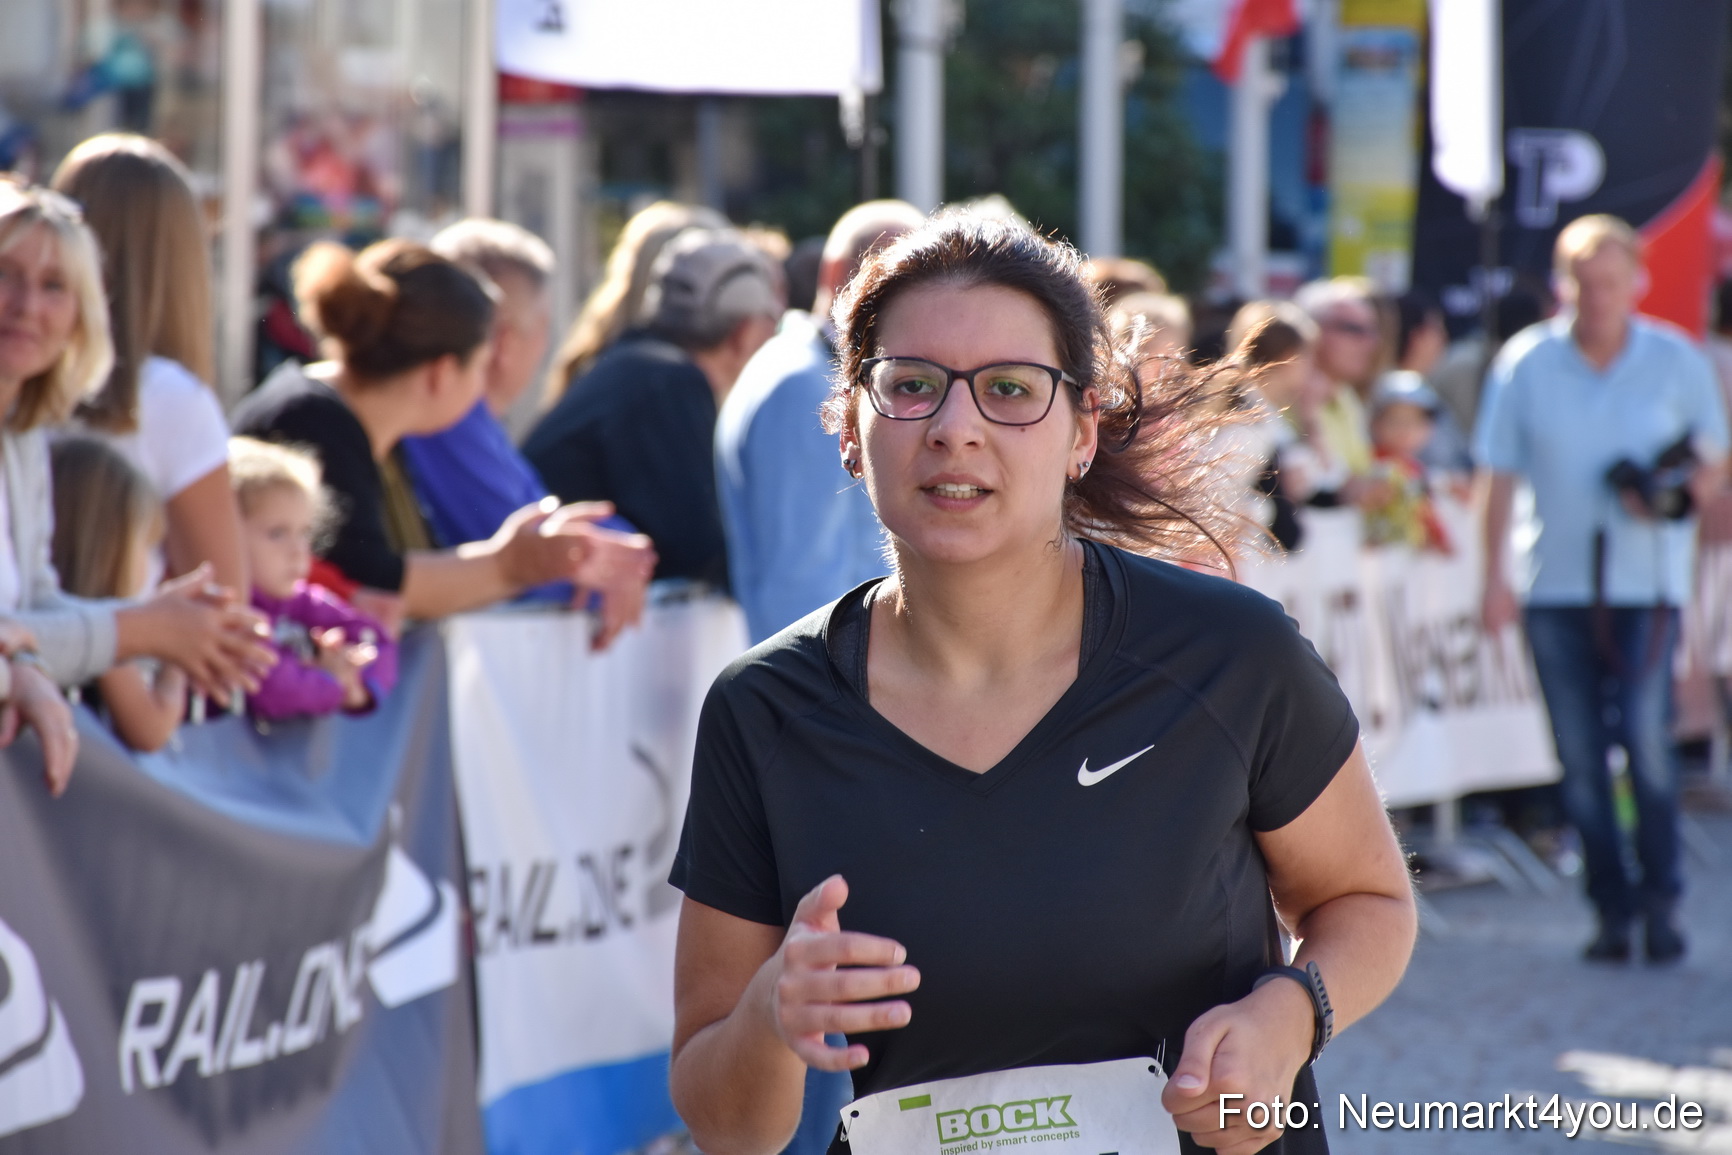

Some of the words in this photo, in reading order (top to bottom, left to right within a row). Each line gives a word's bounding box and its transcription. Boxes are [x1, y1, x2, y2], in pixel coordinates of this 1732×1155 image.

[936, 1095, 1078, 1144] BOCK
[940, 1141, 978, 1155] inspired
[981, 1140, 993, 1151] by
[996, 1134, 1027, 1147] smart
[1030, 1130, 1080, 1143] concepts
